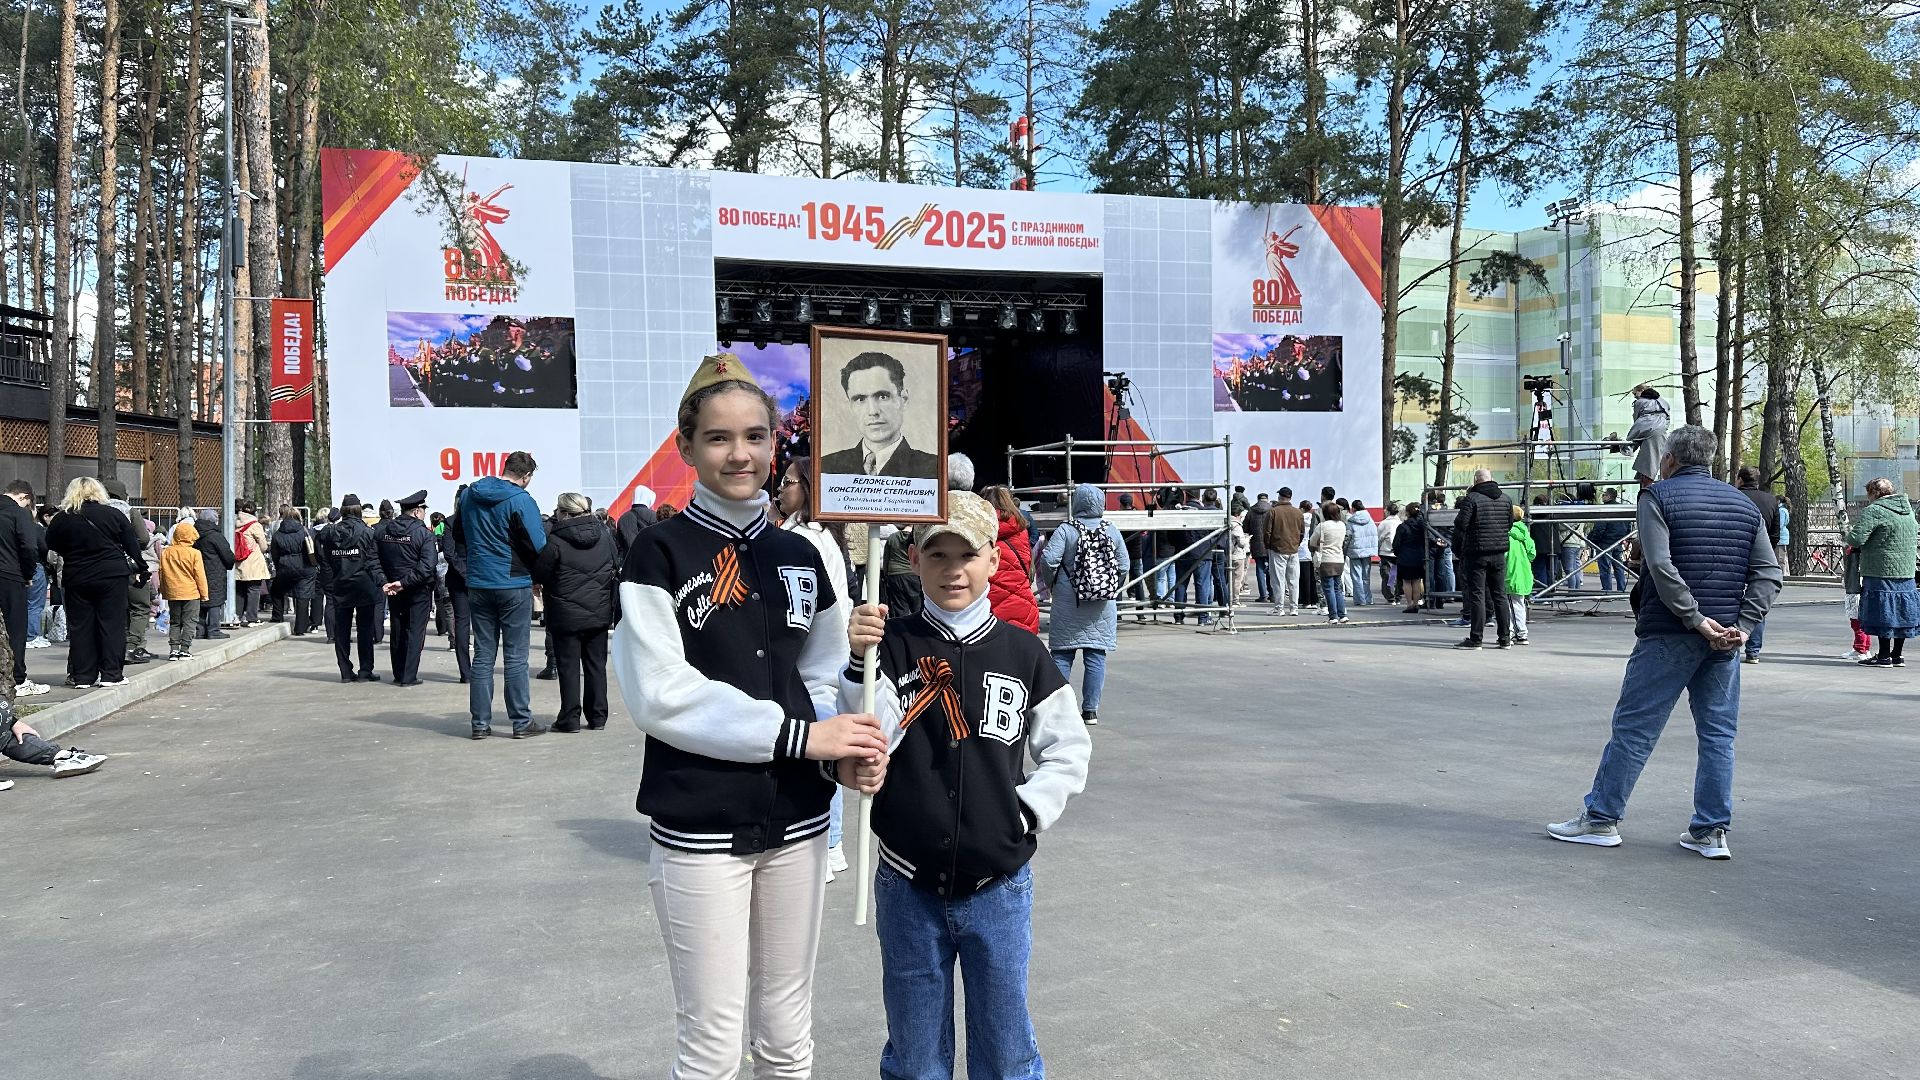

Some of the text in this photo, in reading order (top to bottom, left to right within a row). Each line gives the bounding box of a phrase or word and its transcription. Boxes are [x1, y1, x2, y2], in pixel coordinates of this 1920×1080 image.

[718, 207, 801, 230] 80 ПОБЕДА!
[801, 201, 1006, 250] 1945 2025
[1011, 221, 1084, 234] С ПРАЗДНИКОМ
[1011, 235, 1099, 249] ВЕЛИКОЙ ПОБЕДЫ!
[445, 285, 518, 305] ПОБЕДА!
[1252, 279, 1280, 305] 80
[1252, 309, 1303, 326] ПОБЕДА!
[283, 312, 303, 375] ПОБЕДА!
[440, 447, 461, 481] 9
[1247, 444, 1311, 473] 9 МАЯ
[828, 486, 936, 497] КОНСТАНТИН СТЕПАНОВИЧ
[675, 571, 714, 613] innesota
[777, 566, 819, 633] B
[978, 671, 1029, 747] B
